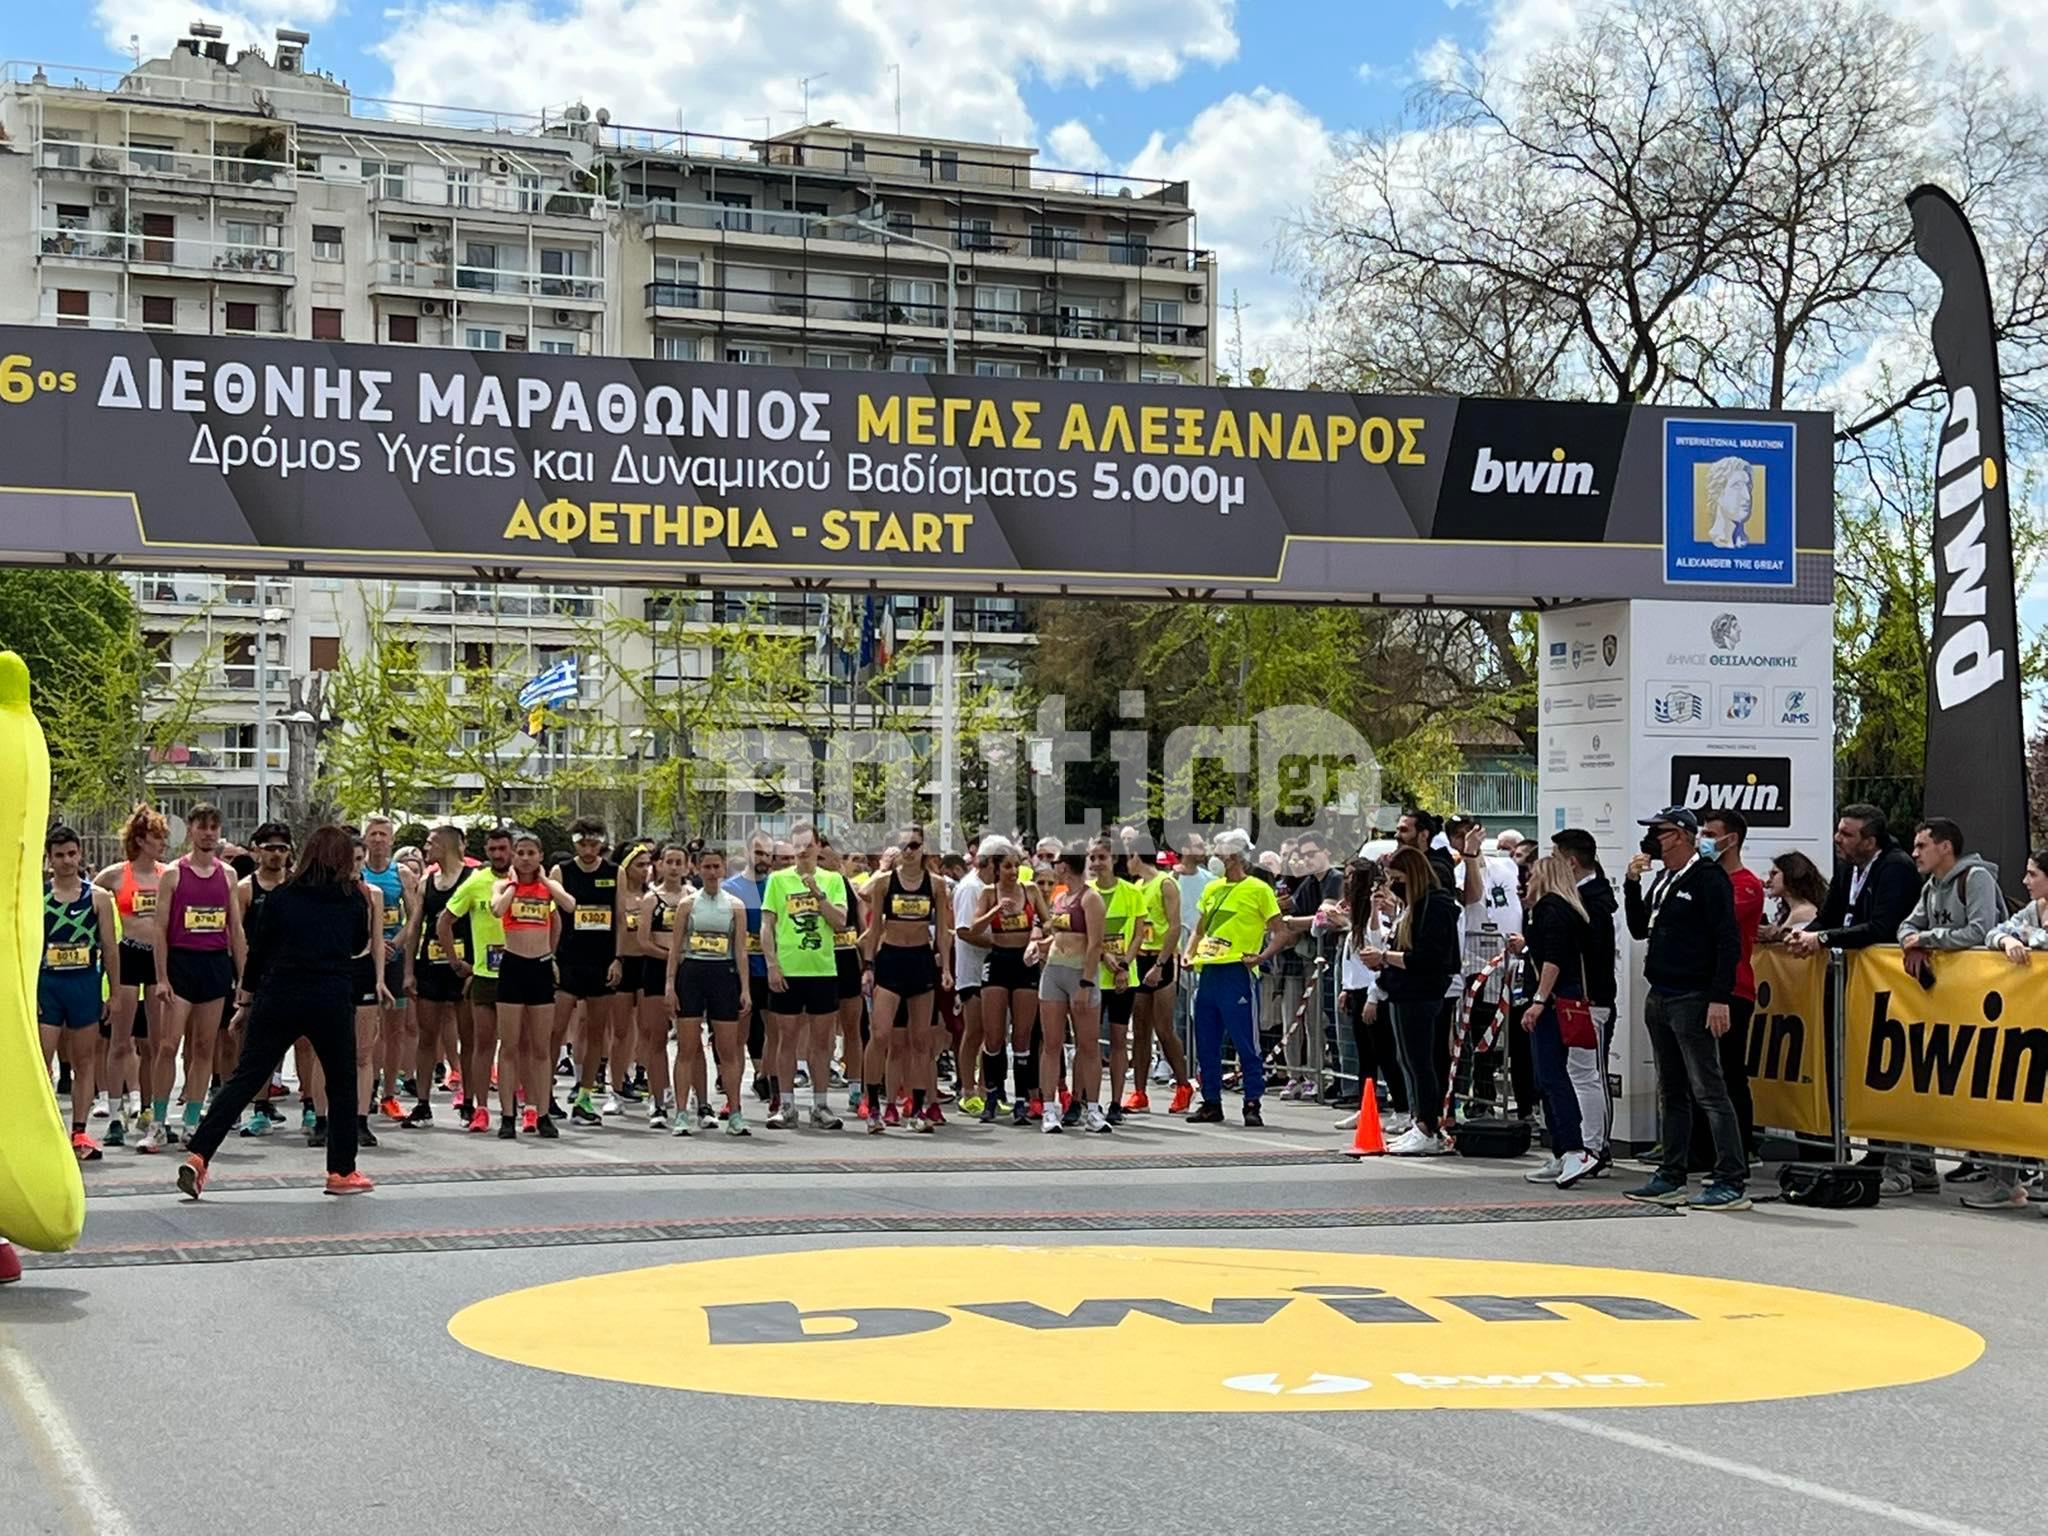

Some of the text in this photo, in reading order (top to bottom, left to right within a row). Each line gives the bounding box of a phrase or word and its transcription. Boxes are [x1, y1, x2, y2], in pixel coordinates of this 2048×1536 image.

[97, 355, 393, 423] ΔΙΕΘΝΗΣ
[418, 371, 831, 442] ΜΑΡΑΘΩΝΙΟΣ
[857, 393, 1042, 450] ΜΕΓΑΣ
[1059, 402, 1426, 465] ΑΛΕΞΑΝΔΡΟΣ
[1675, 436, 1784, 449] INTERNATIONAL MARATHON
[188, 422, 1245, 514] Δρόμος Υγείας και Δυναμικού Βαδίσματος 5.000μ
[503, 499, 778, 548] ΑΦΕΤΗΡΙΑ
[820, 509, 975, 555] START
[1675, 557, 1784, 570] ALEXANDER THE GREAT
[1709, 655, 1798, 668] ΘΕΣΣΑΛΟΝΙΚΗΣ
[1781, 713, 1810, 724] AIMS
[581, 912, 606, 924] 6302
[701, 1285, 1703, 1344] bwin
